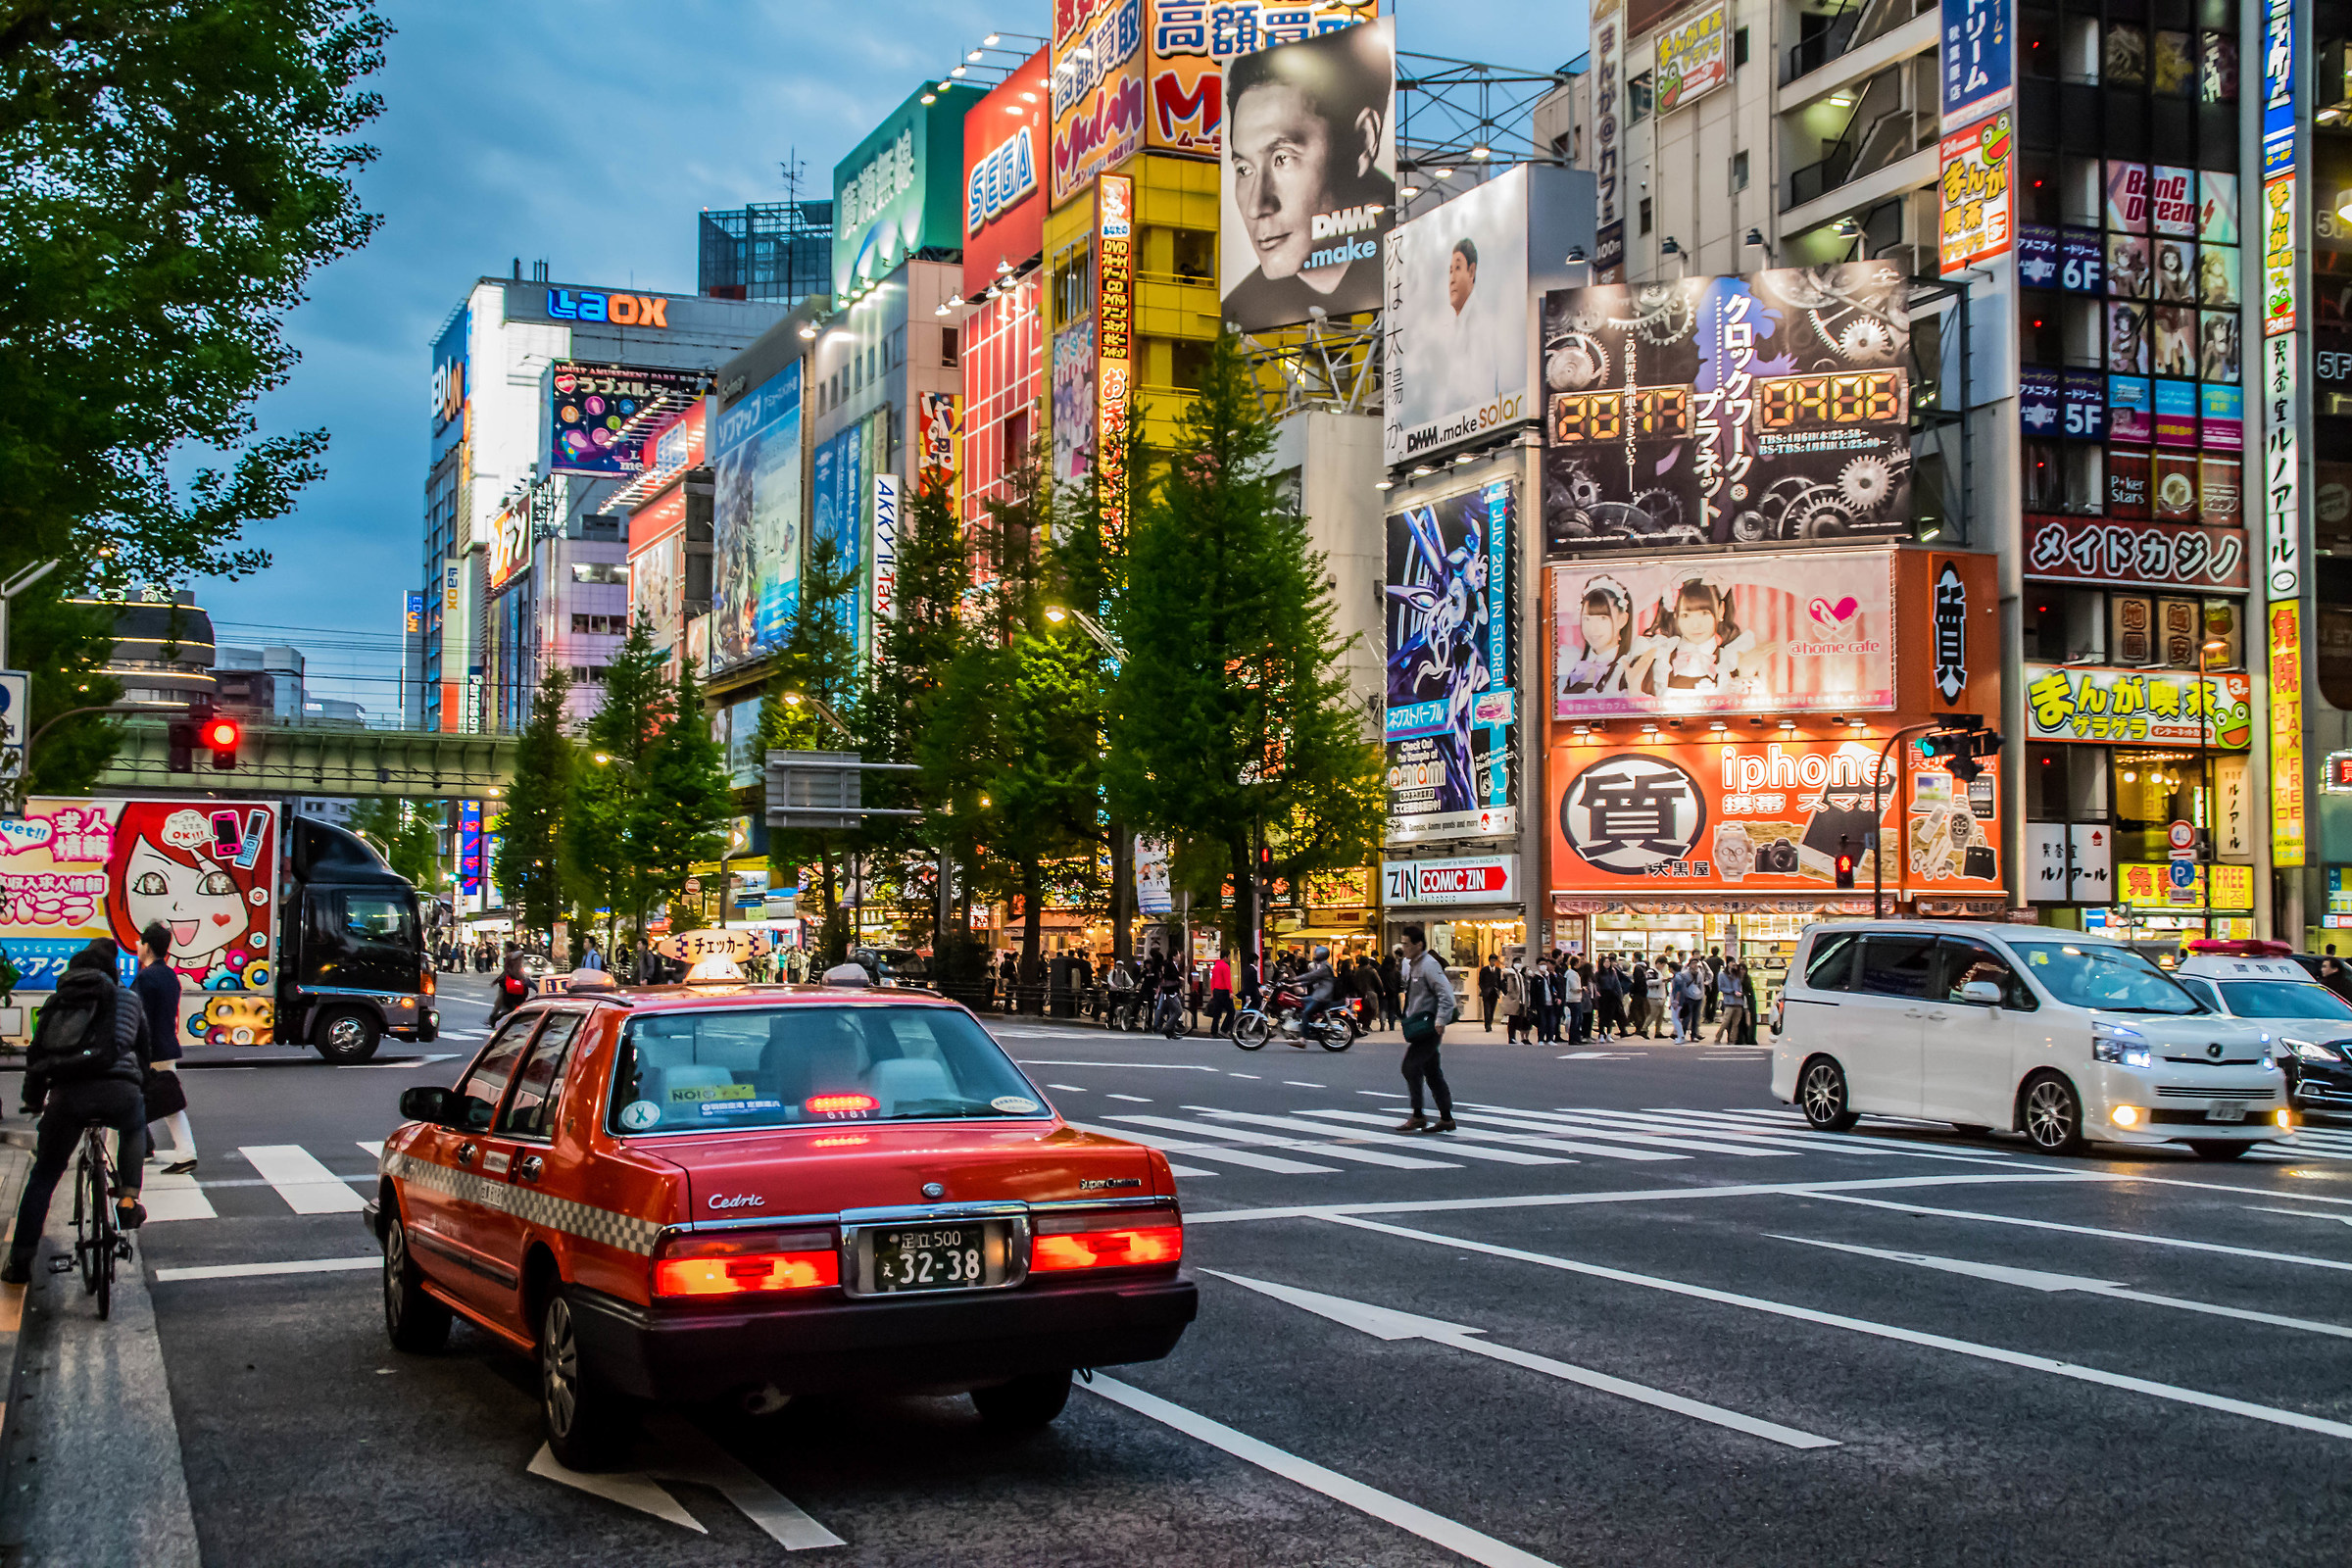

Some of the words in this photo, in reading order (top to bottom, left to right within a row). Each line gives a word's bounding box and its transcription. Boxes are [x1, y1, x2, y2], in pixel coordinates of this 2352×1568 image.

[969, 125, 1038, 233] SEGA
[1943, 158, 2008, 204] まんが
[1311, 203, 1376, 241] DMM
[1103, 240, 1127, 254] DVD
[1303, 236, 1377, 270] .make
[1102, 267, 1128, 279] ゲーム
[1106, 280, 1124, 292] CD
[2063, 259, 2101, 290] 6F
[1102, 306, 1128, 318] アニメ
[1103, 318, 1127, 332] コミック
[1103, 332, 1127, 345] ホビー
[1385, 231, 1403, 463] 次は太陽か。
[2317, 351, 2352, 380] 5F
[1724, 294, 1754, 482] クロックワーク
[1479, 392, 1523, 429] solar
[2065, 403, 2102, 434] 5F
[1693, 387, 1725, 527] プラネット
[2112, 489, 2144, 505] Stars
[877, 479, 896, 551] AKKY
[1492, 508, 1503, 547] JULY
[2031, 522, 2243, 584] メイドカジノ
[1492, 553, 1503, 594] 2017
[877, 571, 896, 613] Tax
[1492, 601, 1503, 618] IN
[1789, 642, 1844, 657] @home
[1847, 640, 1881, 654] cafe
[2272, 609, 2298, 695] 免税
[2029, 669, 2219, 729] まんが喫茶
[2229, 677, 2249, 696] 3F
[1389, 702, 1445, 729] ネクストパープル
[2071, 714, 2148, 740] ゲラゲラ
[2288, 701, 2299, 749] TAX
[1390, 760, 1446, 790] amiami
[1722, 743, 1889, 795] iphone
[2290, 757, 2302, 819] FREE
[1577, 767, 1692, 861] 質
[1722, 793, 1787, 814] 携帯
[1796, 793, 1892, 813] スマホ
[2228, 784, 2241, 850] ルノアール
[1, 821, 47, 842] Get!!
[56, 810, 110, 834] 求人
[55, 835, 110, 858] 情報
[1420, 869, 1464, 893] COMIC
[1465, 868, 1486, 891] ZIN
[1649, 860, 1711, 878] 大黒屋
[2041, 866, 2108, 883] ルノアール
[2216, 867, 2245, 889] FREE
[1387, 863, 1417, 903] ZIN
[694, 937, 745, 956] チェッカー
[1622, 940, 1644, 949] iPhone
[2232, 962, 2292, 974] 警視庁
[826, 1109, 868, 1120] 6181
[1079, 1178, 1105, 1192] Super
[708, 1192, 765, 1210] Cedric
[902, 1233, 930, 1250] 足立
[934, 1230, 961, 1248] 500
[900, 1249, 980, 1285] 32-38
